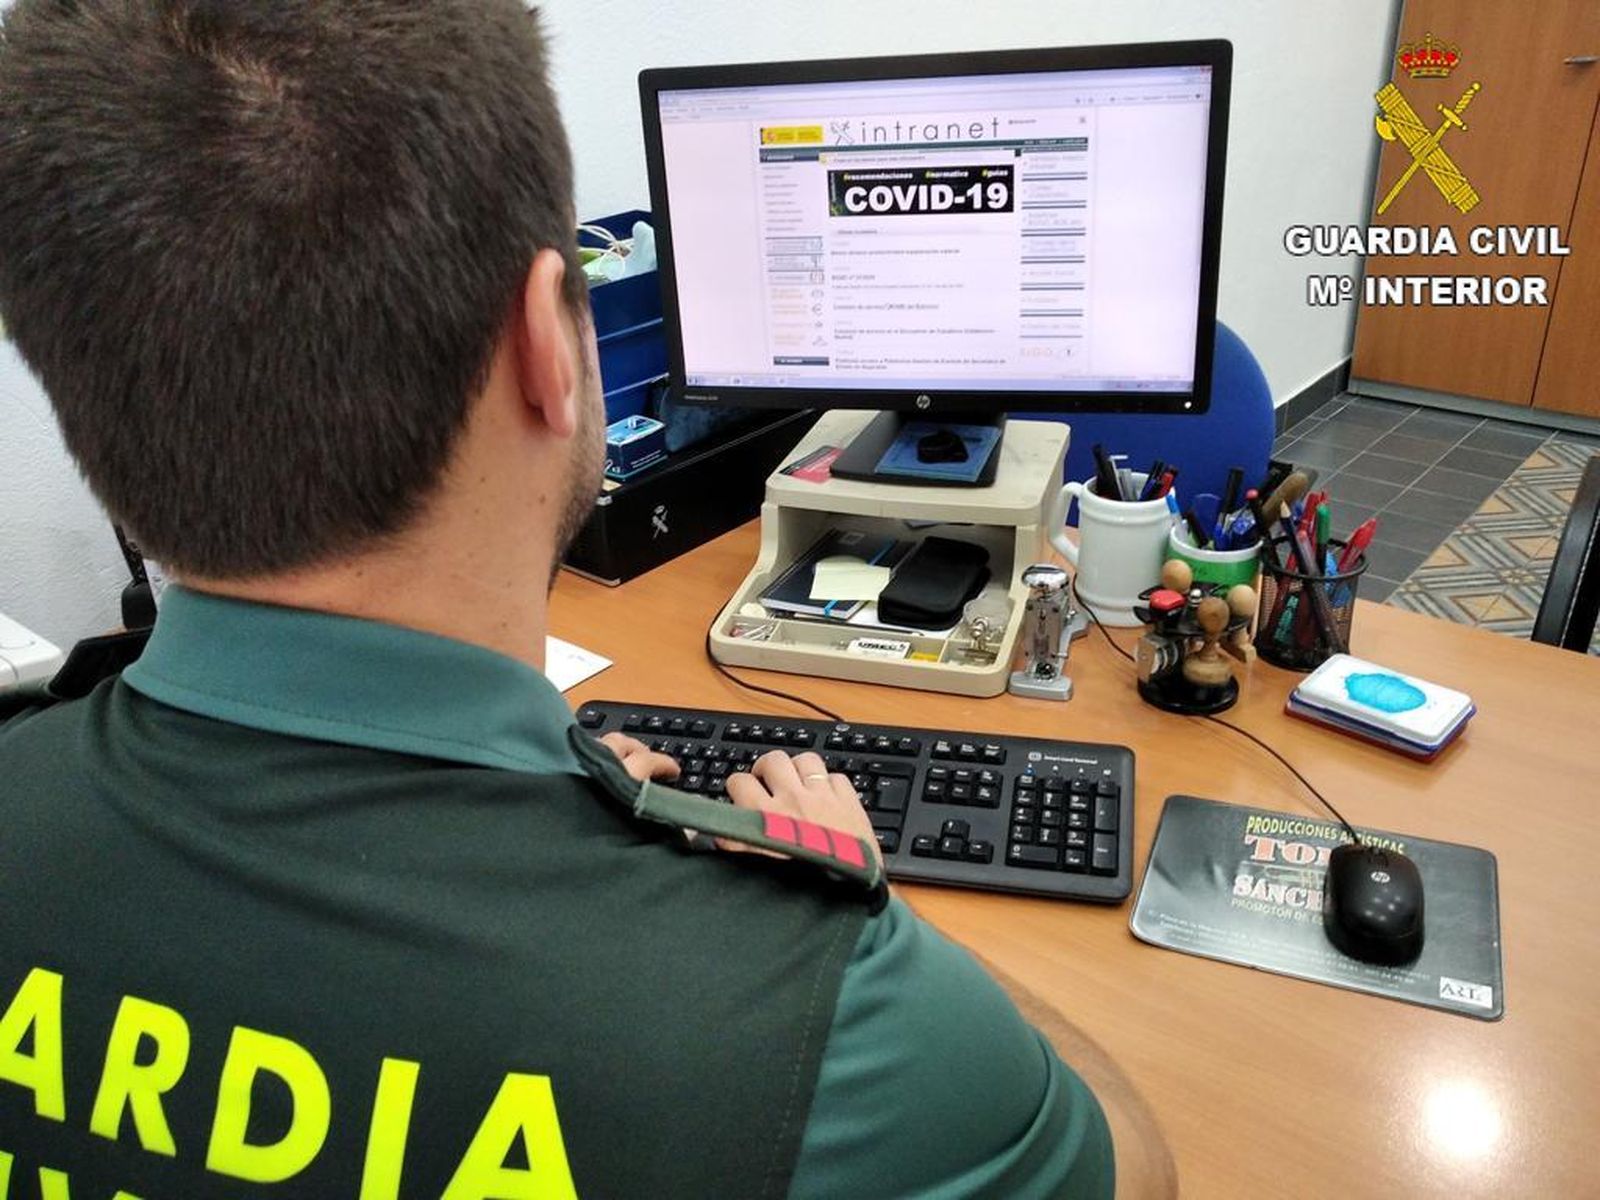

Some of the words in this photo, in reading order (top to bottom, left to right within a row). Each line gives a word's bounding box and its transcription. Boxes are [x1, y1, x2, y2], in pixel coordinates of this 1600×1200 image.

[862, 117, 1000, 143] intranet
[844, 182, 1009, 213] COVID-19
[1246, 815, 1337, 840] PRODUCCIONES
